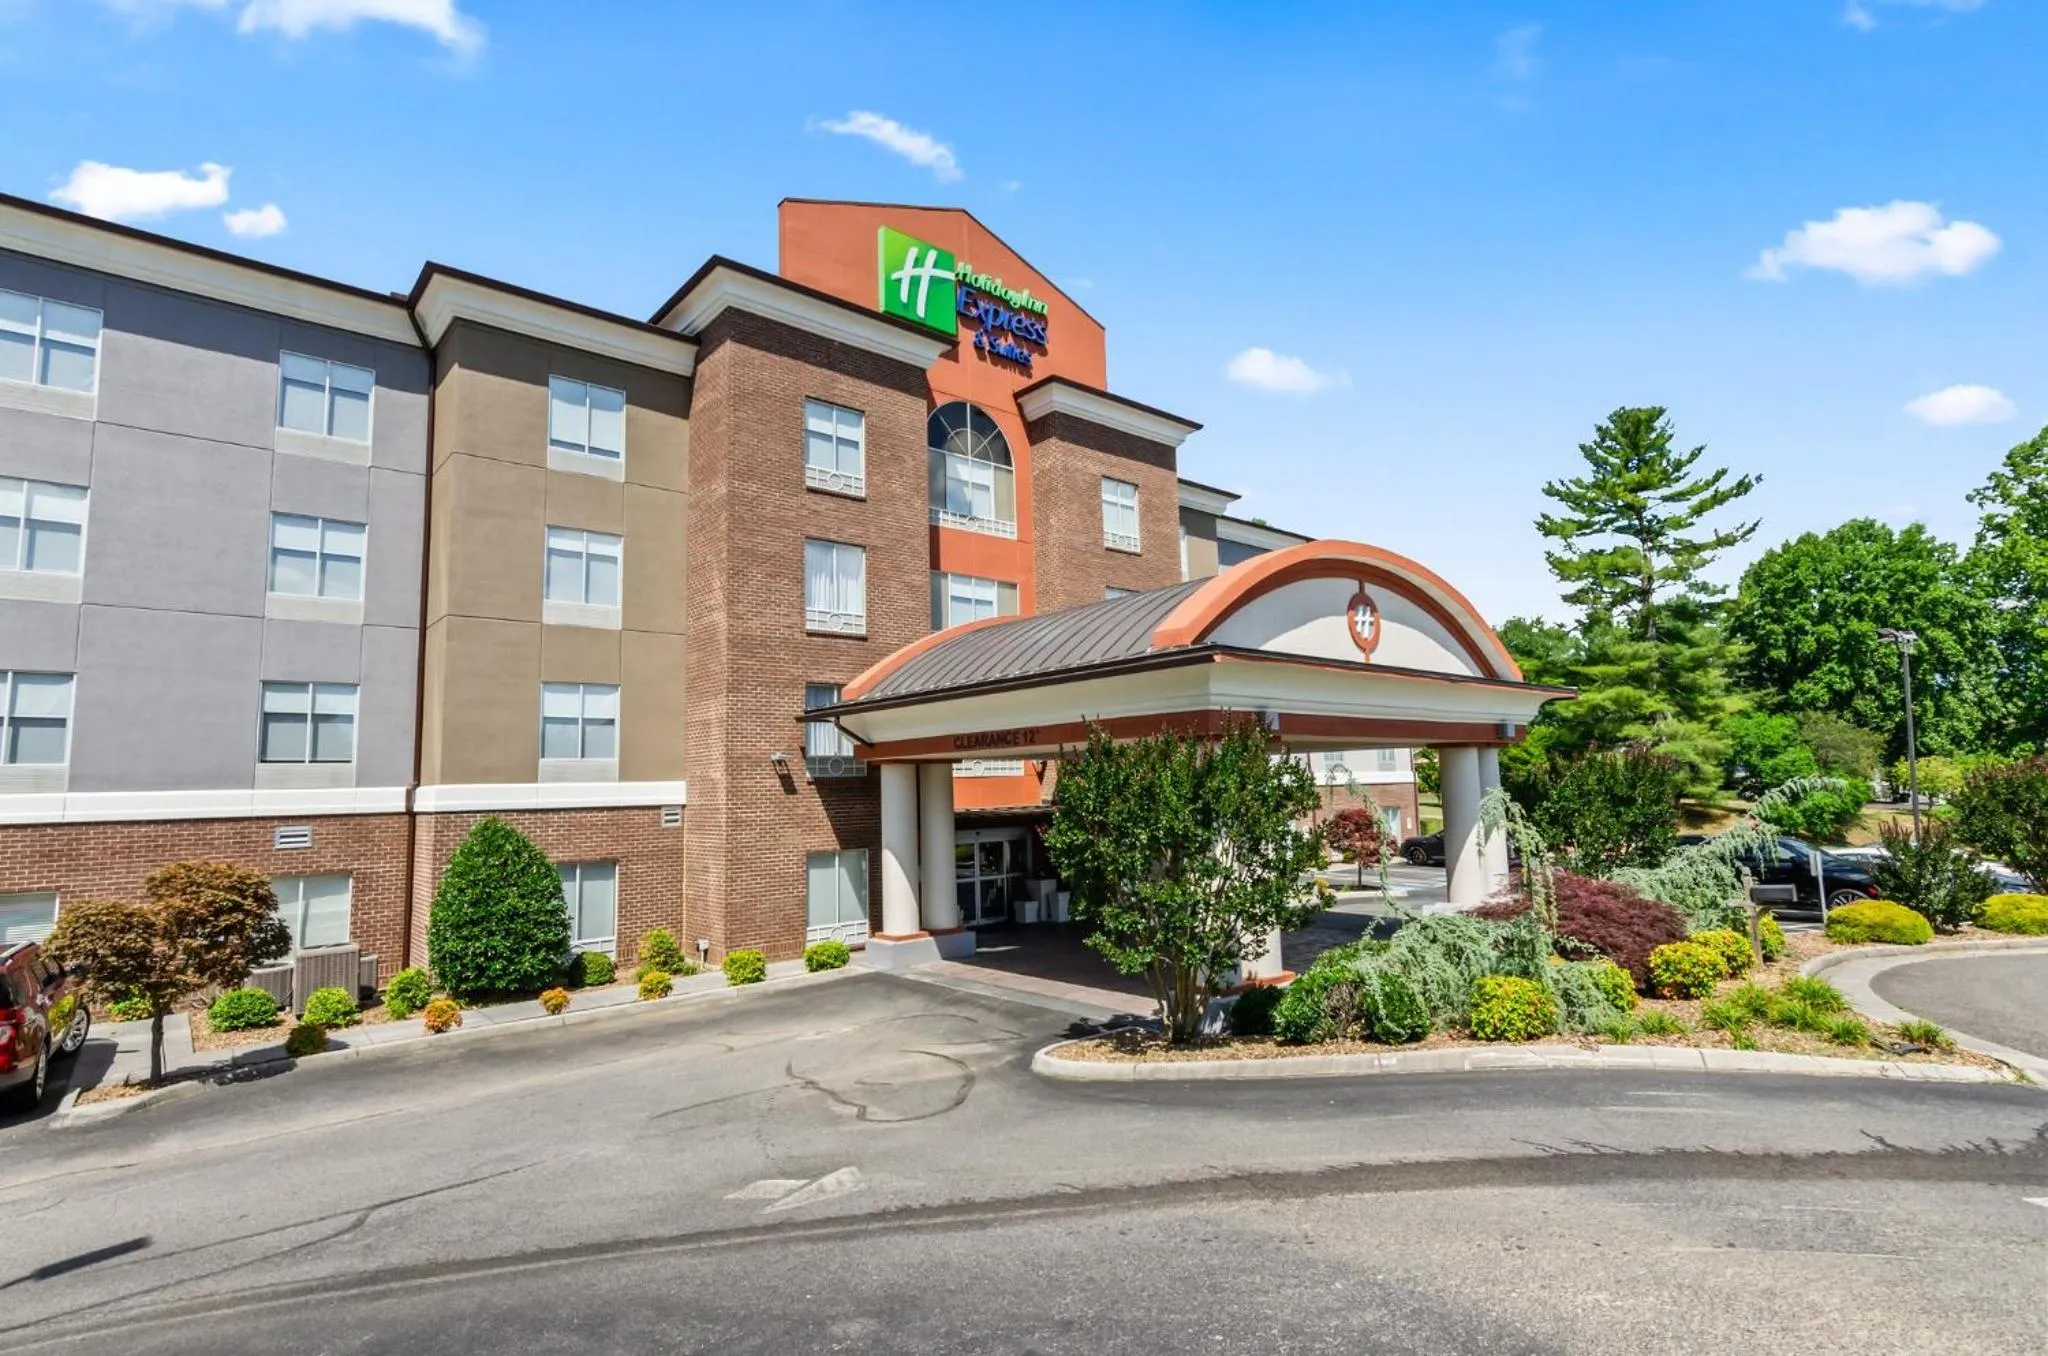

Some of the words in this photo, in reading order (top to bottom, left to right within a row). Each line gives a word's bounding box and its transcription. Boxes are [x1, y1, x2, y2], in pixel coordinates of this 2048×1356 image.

[956, 262, 1021, 308] Holiday
[1020, 288, 1048, 316] Inn
[957, 285, 1047, 346] Express
[974, 330, 986, 348] &
[988, 335, 1031, 366] Suites
[953, 731, 1020, 749] CLEARANCE
